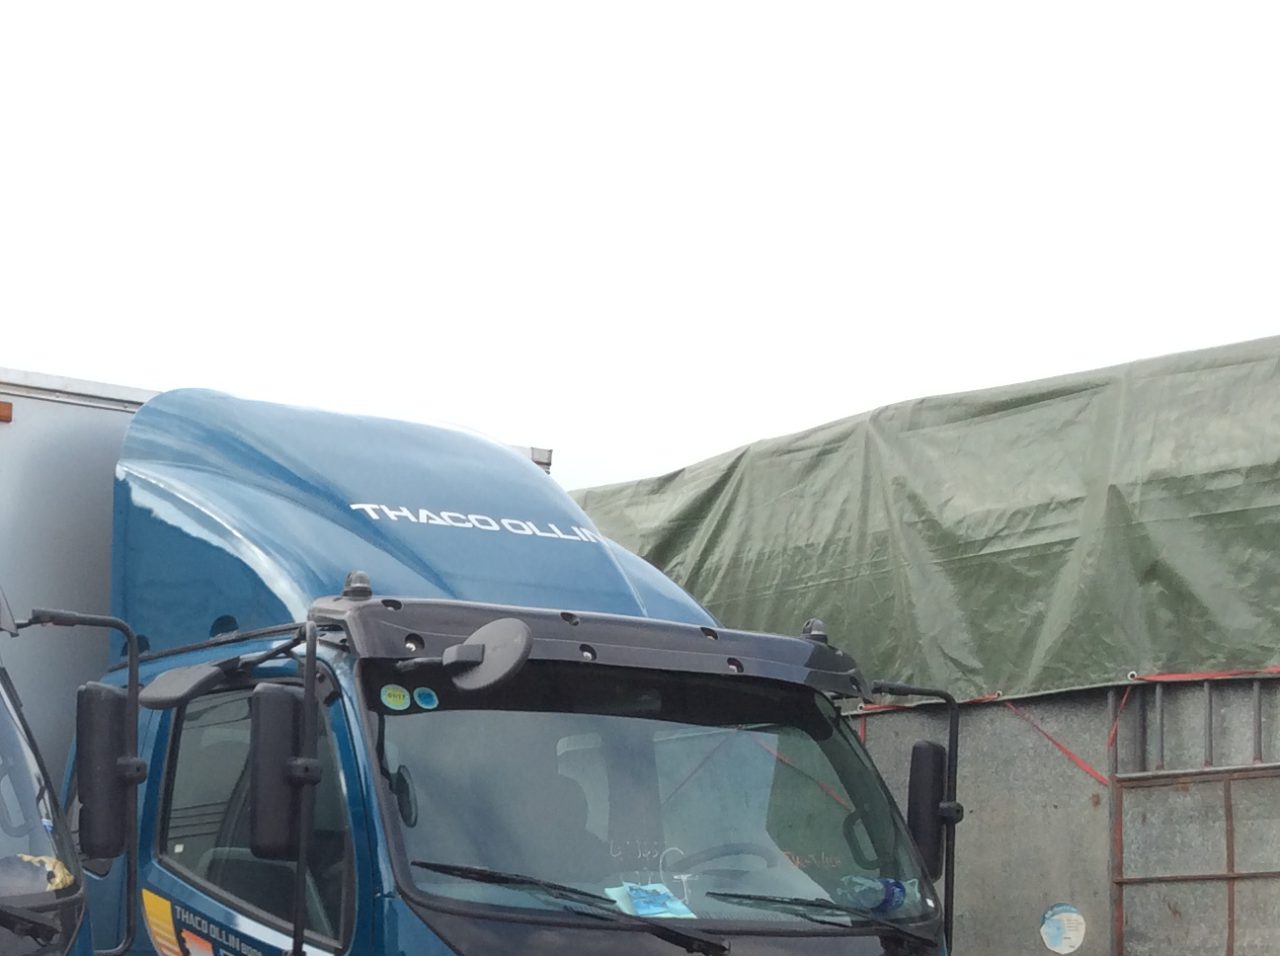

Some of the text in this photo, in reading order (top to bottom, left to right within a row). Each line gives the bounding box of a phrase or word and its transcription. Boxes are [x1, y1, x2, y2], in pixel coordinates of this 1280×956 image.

[349, 503, 604, 543] THACO OLLIN
[175, 906, 208, 933] THACO
[209, 924, 240, 950] OLLIN
